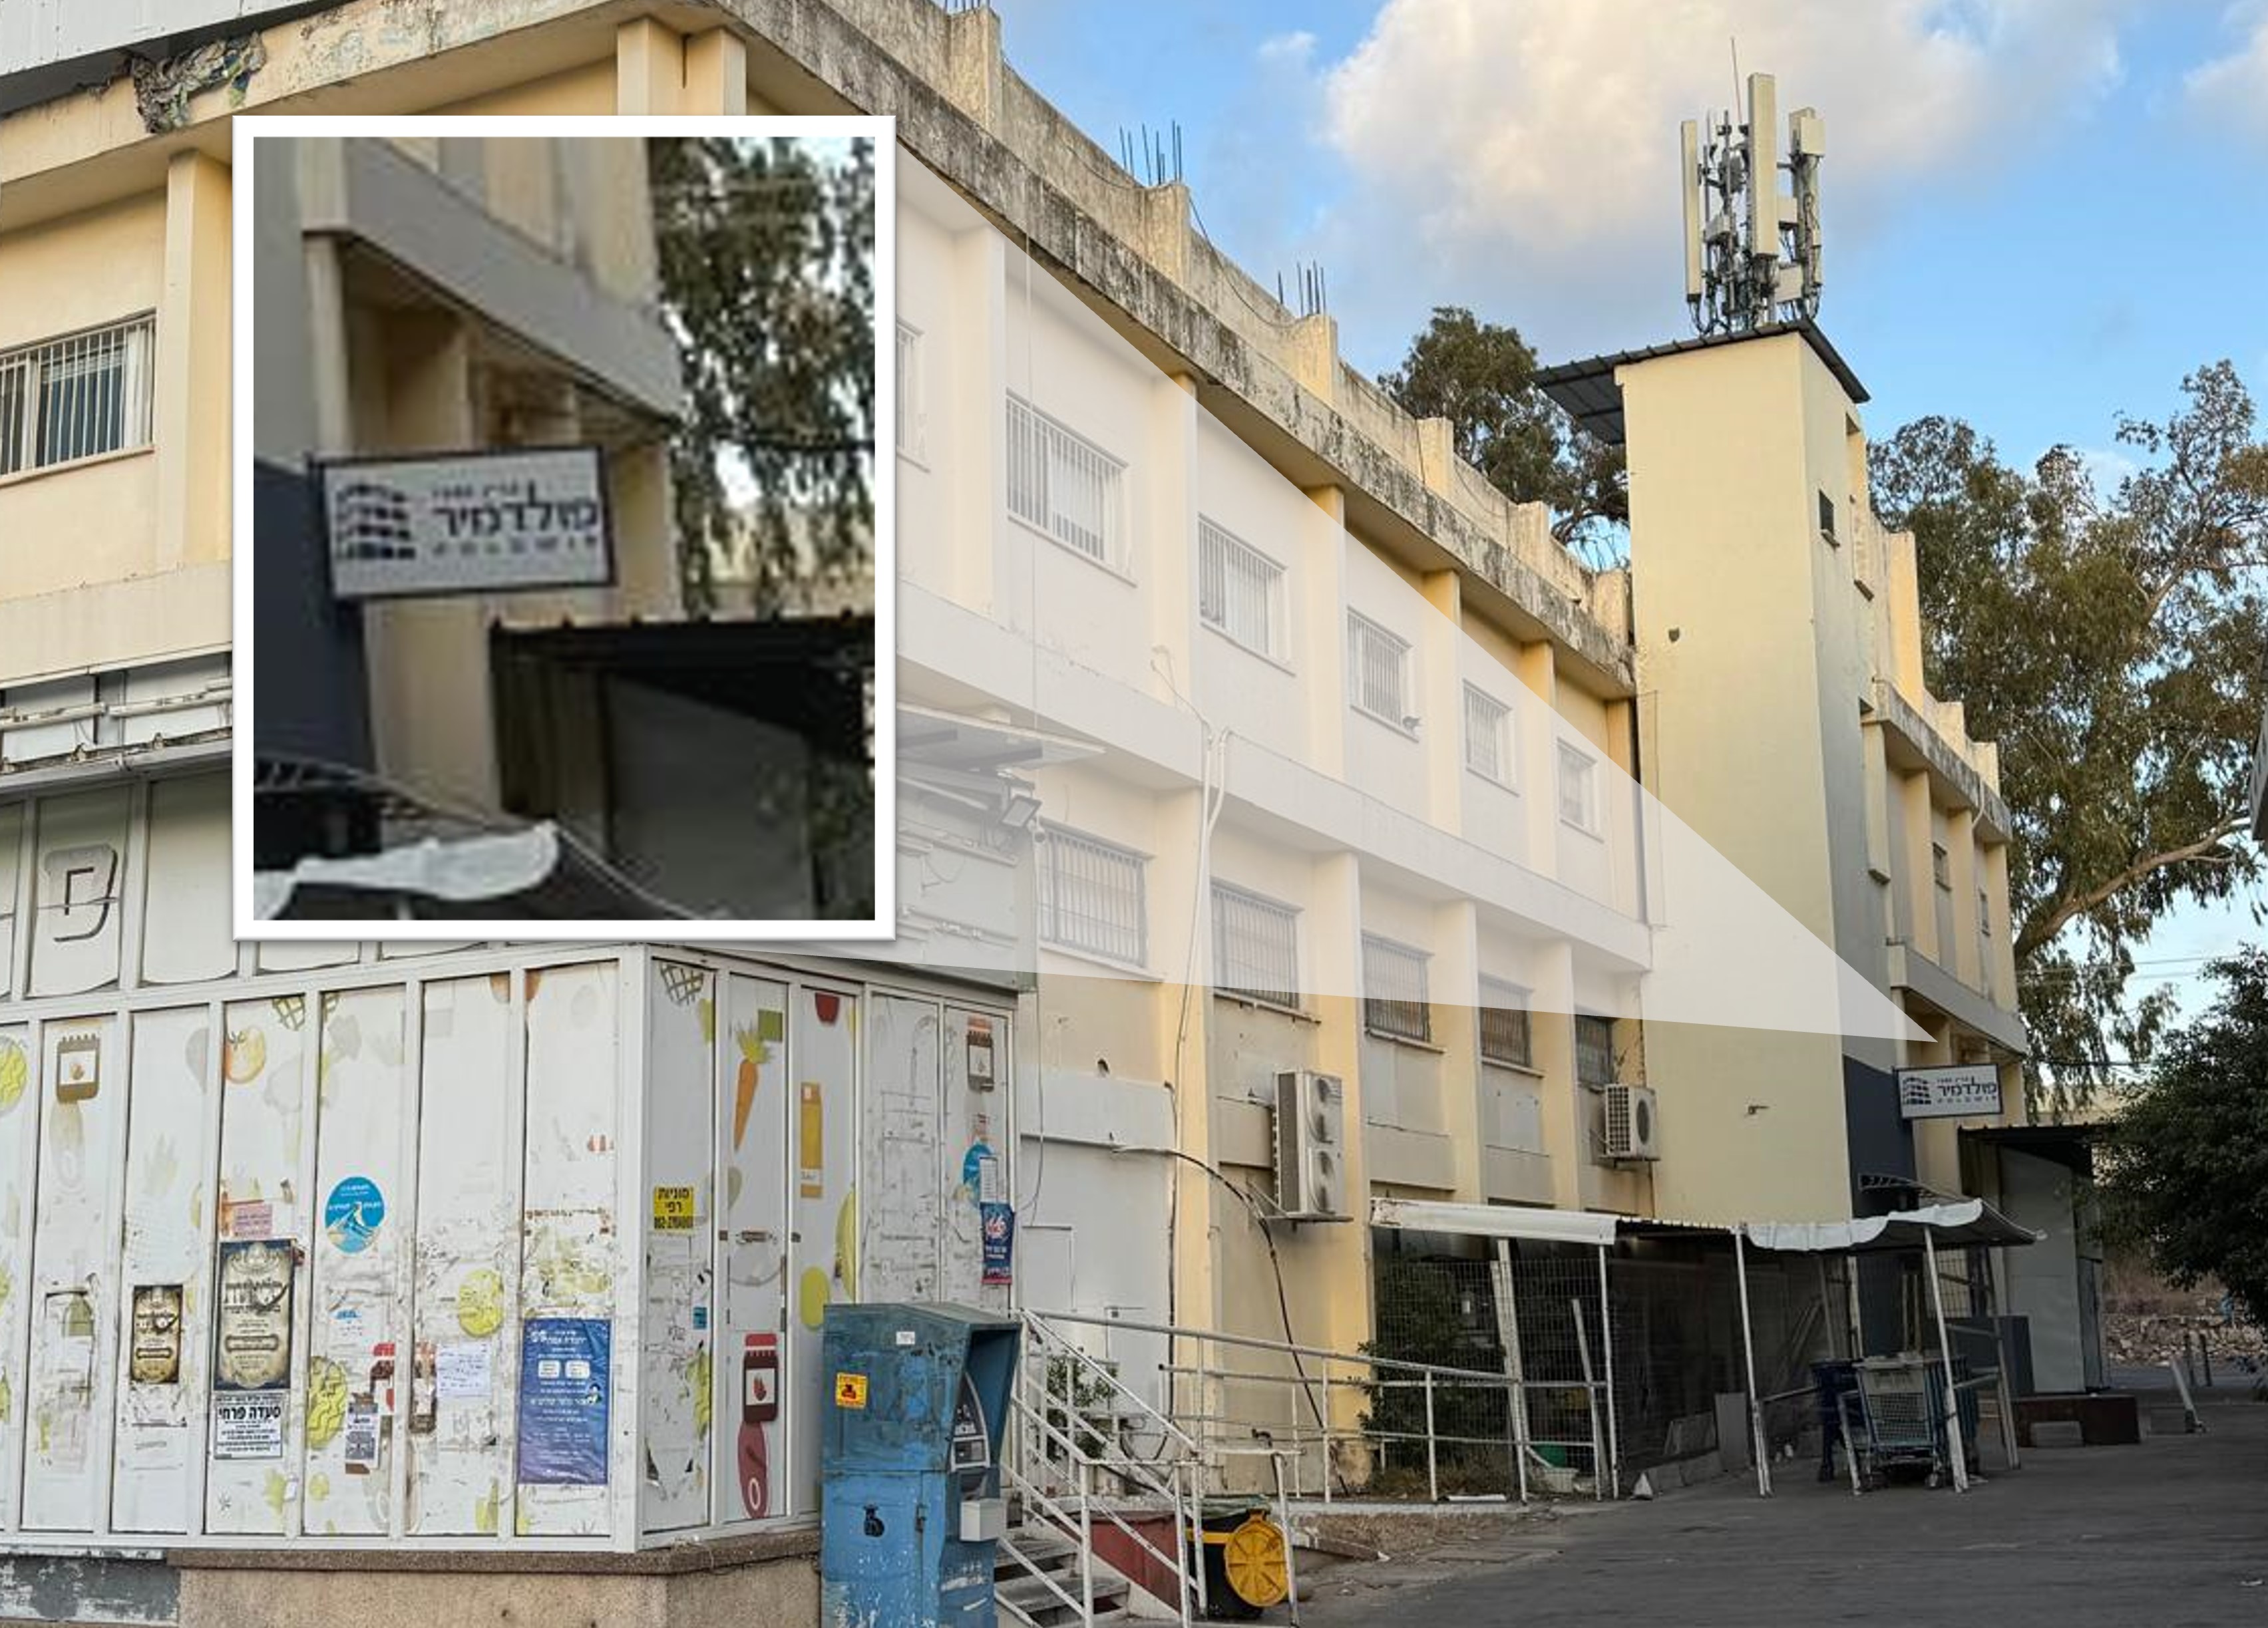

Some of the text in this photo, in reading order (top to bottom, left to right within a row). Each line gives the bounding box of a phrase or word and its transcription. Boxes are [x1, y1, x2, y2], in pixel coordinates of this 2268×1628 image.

[658, 1187, 689, 1200] מוניות
[665, 1201, 682, 1213] רפי
[218, 1406, 281, 1420] סעדה פרחי
